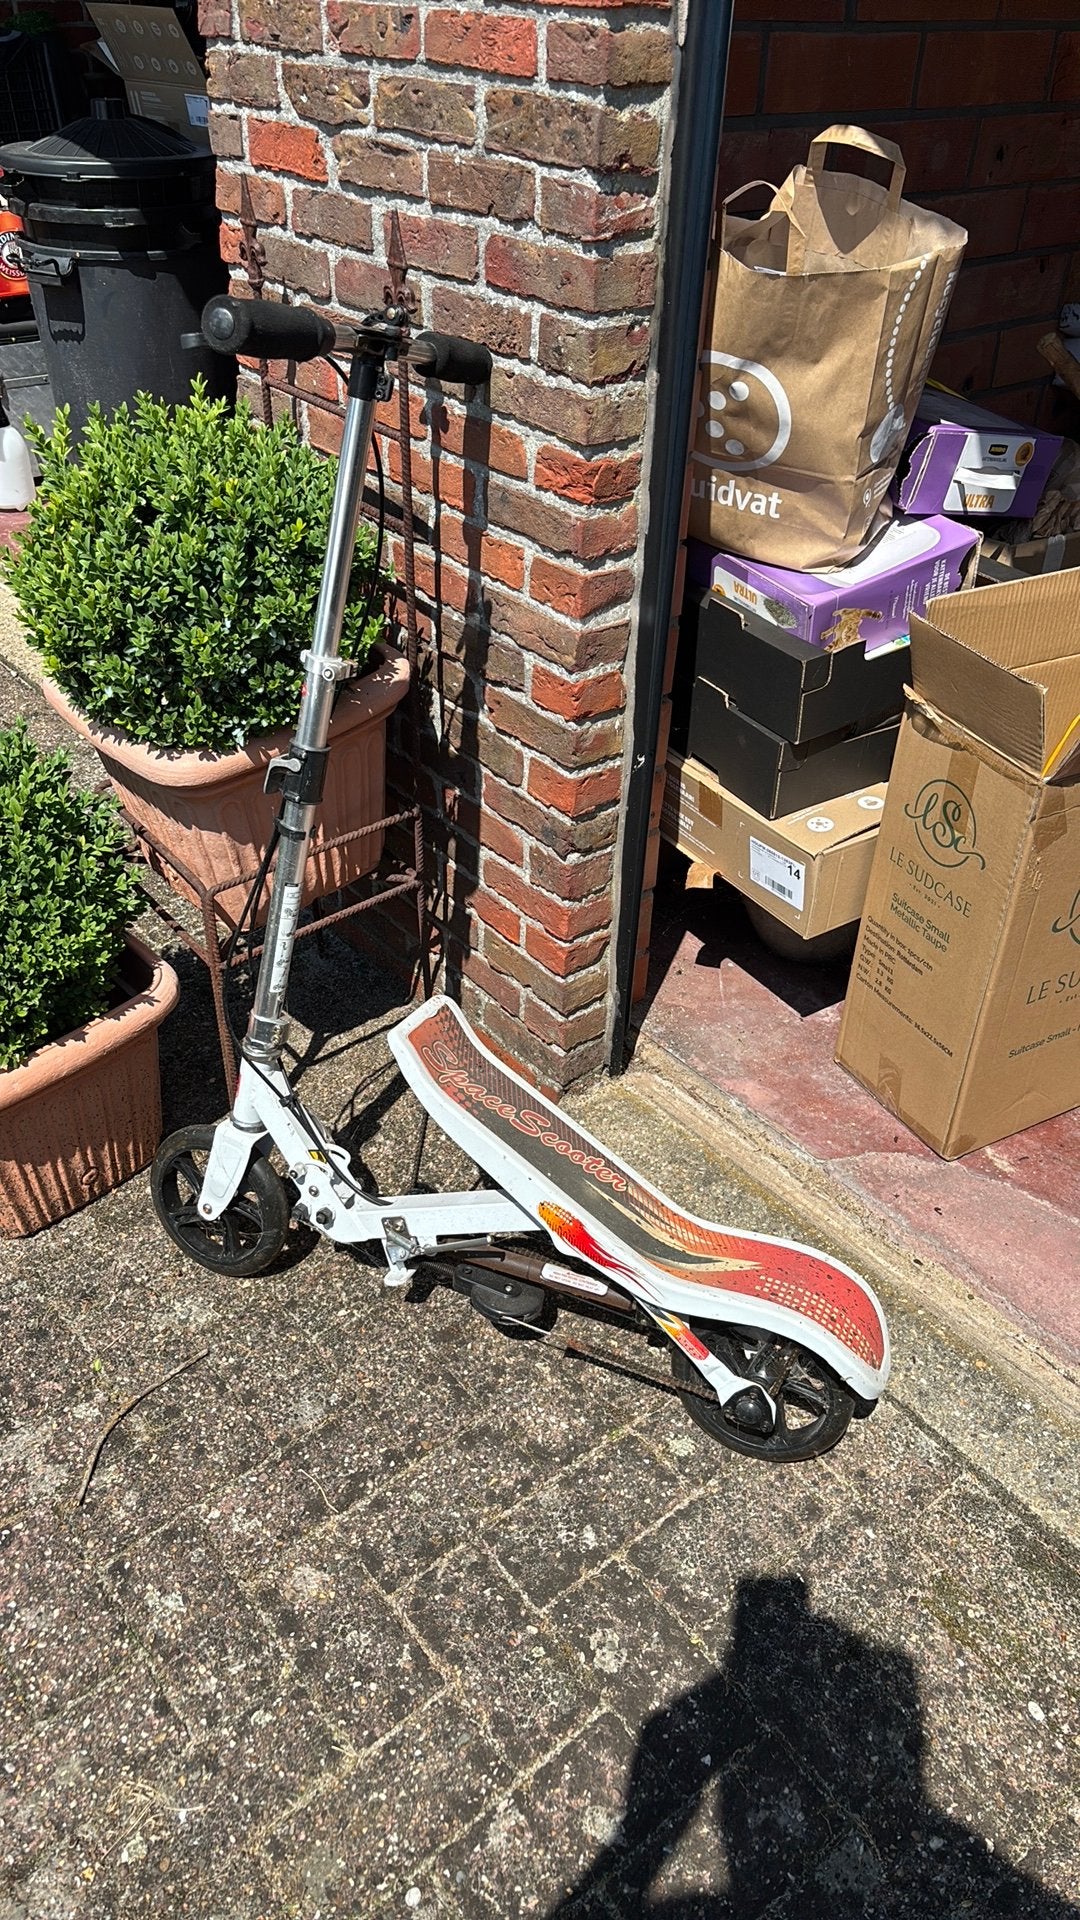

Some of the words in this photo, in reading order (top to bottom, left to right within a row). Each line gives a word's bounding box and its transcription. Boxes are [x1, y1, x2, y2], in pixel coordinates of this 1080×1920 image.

[963, 493, 996, 509] ULTRA
[733, 580, 758, 605] ULTRA
[787, 865, 801, 881] 14
[889, 846, 905, 869] LE
[906, 859, 972, 918] SUDCASE
[868, 915, 890, 938] Quantity
[890, 904, 921, 933] Metallic
[922, 928, 948, 953] Taupe
[892, 892, 925, 924] Suitcase
[926, 919, 951, 944] Small
[864, 935, 879, 951] Made
[897, 951, 924, 976] Rotterdam
[856, 972, 874, 991] Carton
[1026, 980, 1051, 1005] LE
[1008, 1039, 1046, 1059] Suitcase
[1046, 1028, 1072, 1044] Small
